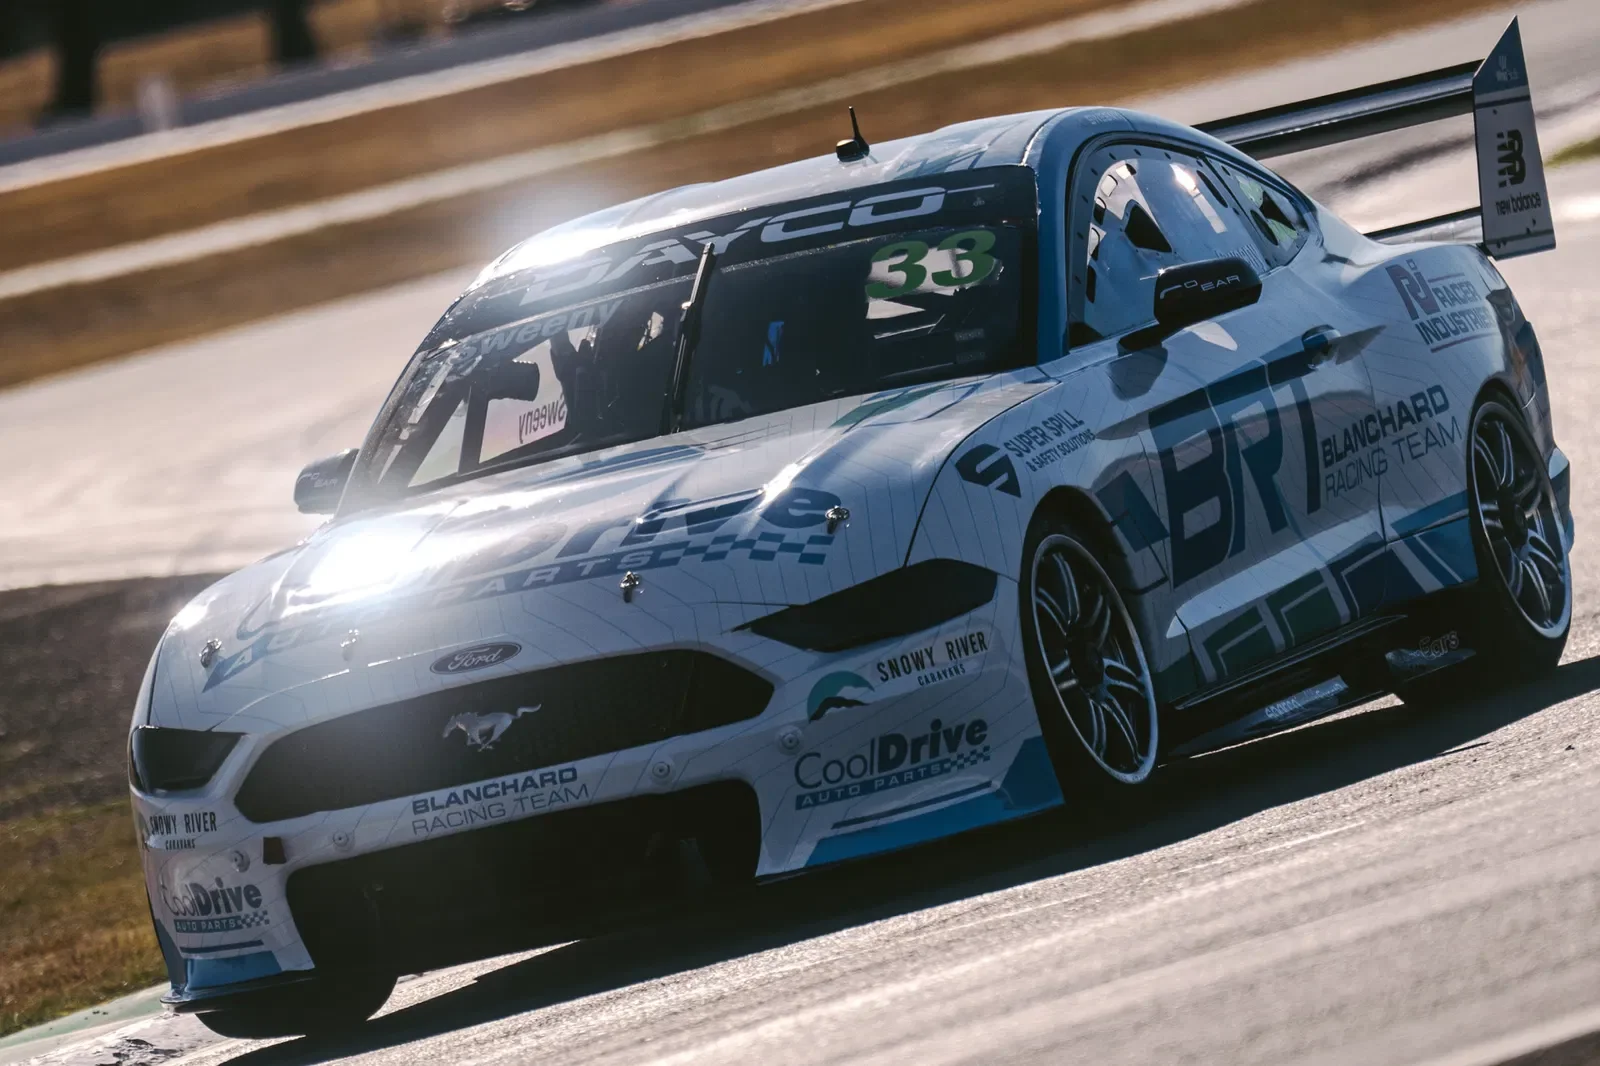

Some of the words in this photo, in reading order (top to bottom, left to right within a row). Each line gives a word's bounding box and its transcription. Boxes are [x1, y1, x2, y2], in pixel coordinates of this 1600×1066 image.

[1496, 199, 1512, 216] new
[1510, 192, 1541, 213] balance
[519, 187, 995, 307] DAYCO
[864, 230, 996, 300] 33
[1431, 281, 1481, 308] RACER
[1003, 426, 1054, 458] SUPER
[1041, 409, 1085, 438] SPILL
[1320, 384, 1450, 468] BLANCHARD
[1025, 458, 1038, 472] &
[1034, 448, 1061, 469] SAFETY
[1056, 428, 1096, 456] SOLUTIONS
[1324, 447, 1388, 500] RACING
[1392, 415, 1464, 466] TEAM
[447, 647, 505, 671] Ford
[876, 647, 936, 682] SNOWY
[945, 631, 989, 661] RIVER
[917, 663, 967, 687] CARAVANS
[794, 718, 989, 790] CoolDrive
[412, 766, 578, 816] BLANCHARD
[801, 786, 861, 808] AUTO
[873, 762, 942, 793] PARTS
[149, 814, 178, 836] SNOWY
[183, 811, 218, 834] RIVER
[411, 802, 506, 836] RACING
[513, 783, 590, 814] TEAM
[165, 838, 196, 851] CARAVANS
[175, 922, 198, 932] AUTO
[201, 919, 237, 931] PARTS
